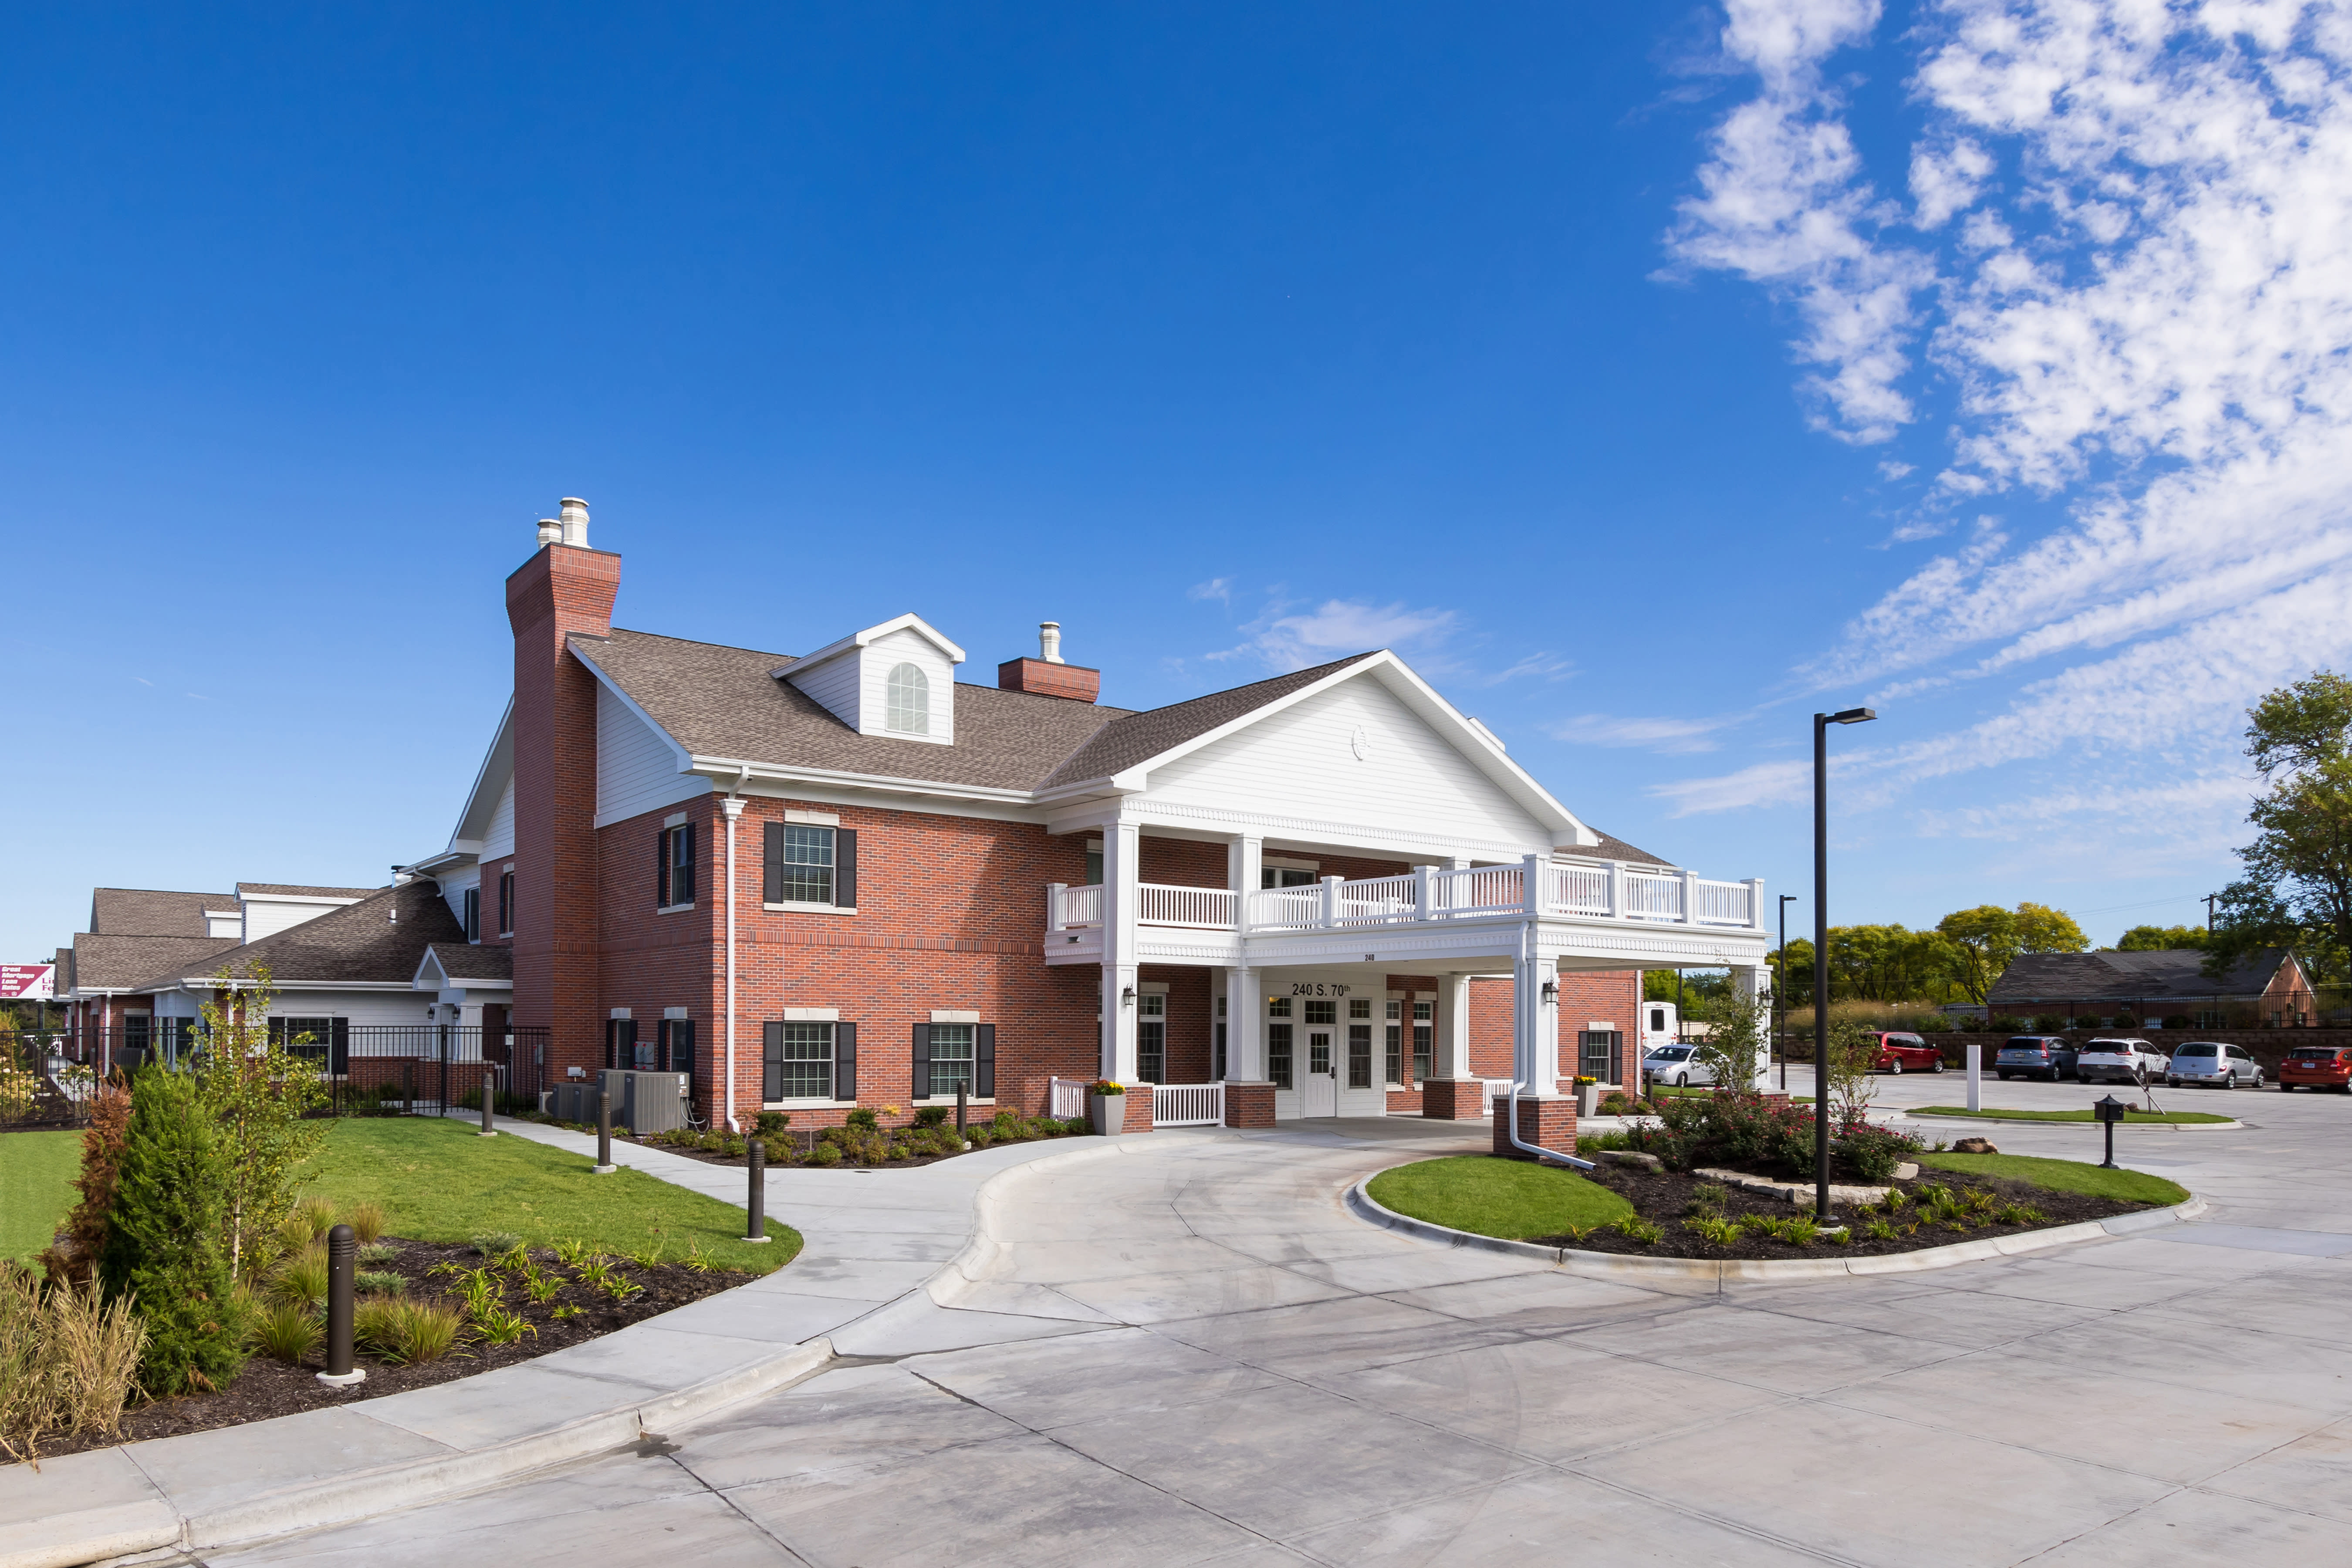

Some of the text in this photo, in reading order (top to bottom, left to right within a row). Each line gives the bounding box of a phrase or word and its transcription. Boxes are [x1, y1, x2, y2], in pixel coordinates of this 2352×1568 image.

[1292, 983, 1351, 997] 240 S. 70th
